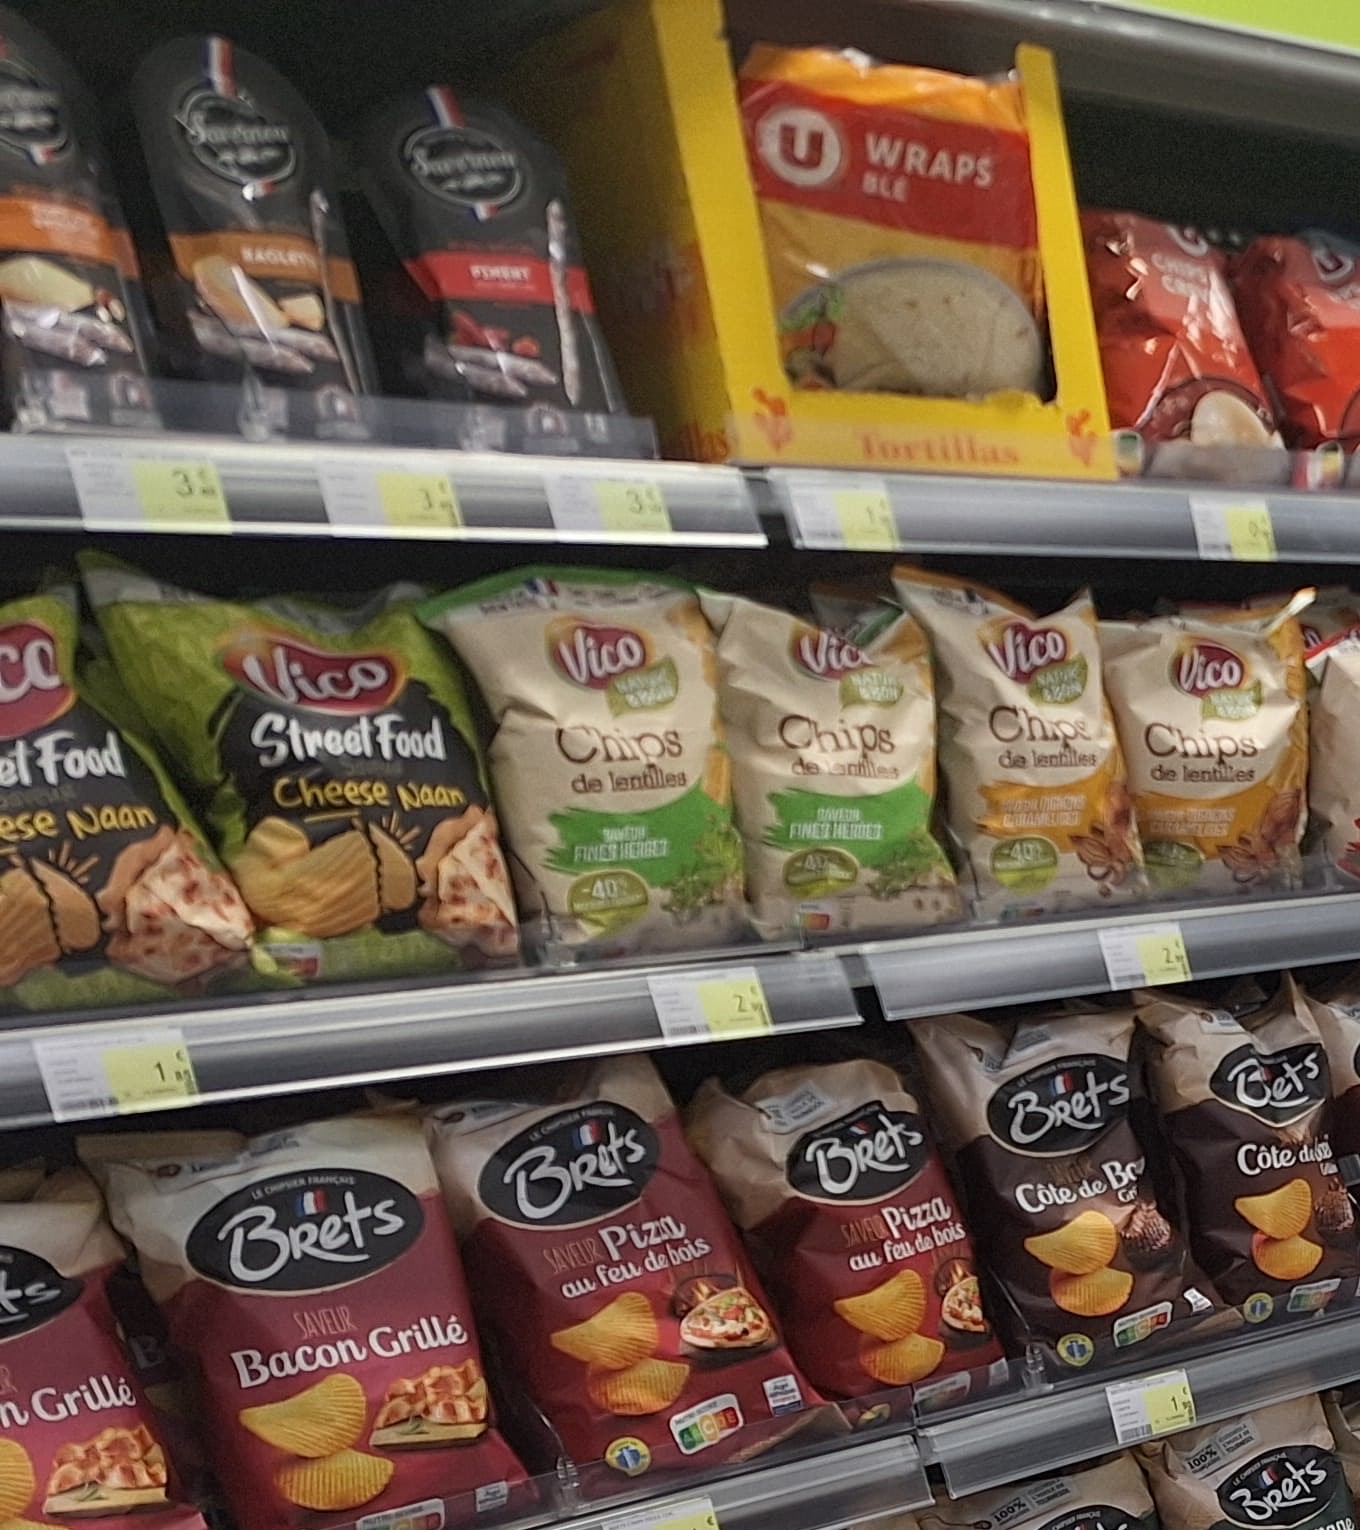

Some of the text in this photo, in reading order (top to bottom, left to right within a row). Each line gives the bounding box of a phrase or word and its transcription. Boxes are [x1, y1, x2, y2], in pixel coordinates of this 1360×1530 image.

[865, 131, 996, 188] WRAPS
[858, 432, 1020, 467] Tortillas
[558, 628, 646, 685] Vico
[989, 623, 1065, 675] Vico
[1177, 646, 1241, 693] Vico
[241, 644, 389, 705] Vico
[252, 713, 446, 767] Street Food
[556, 725, 684, 764] Chips
[778, 714, 896, 761] Chips
[989, 705, 1088, 749] Chips
[1145, 722, 1259, 765] Chips
[571, 768, 688, 793] de lentilles
[791, 752, 900, 779] de lentilles
[998, 748, 1096, 770] de lentilles
[1150, 762, 1255, 782] de lentilles
[273, 777, 464, 812] Cheese Naan
[573, 837, 669, 863] FINES HERBES
[789, 820, 882, 841] FINES HERBES
[734, 993, 747, 1015] 2
[155, 1061, 166, 1082] 1
[1008, 1070, 1130, 1144] Brets
[503, 1120, 647, 1219] Brets
[805, 1114, 925, 1195] Brets
[1237, 1143, 1296, 1176] Côte
[217, 1190, 405, 1283] Brets
[881, 1197, 953, 1240] Pizza
[543, 1213, 687, 1276] SAVEUR Pizza
[562, 1236, 712, 1300] au feu de bois
[849, 1222, 966, 1272] au feu de bois
[293, 1306, 354, 1339] SAVEUR
[230, 1315, 468, 1389] Bacon Grillé
[31, 1375, 137, 1422] Grillé
[1229, 1457, 1327, 1522] Brets
